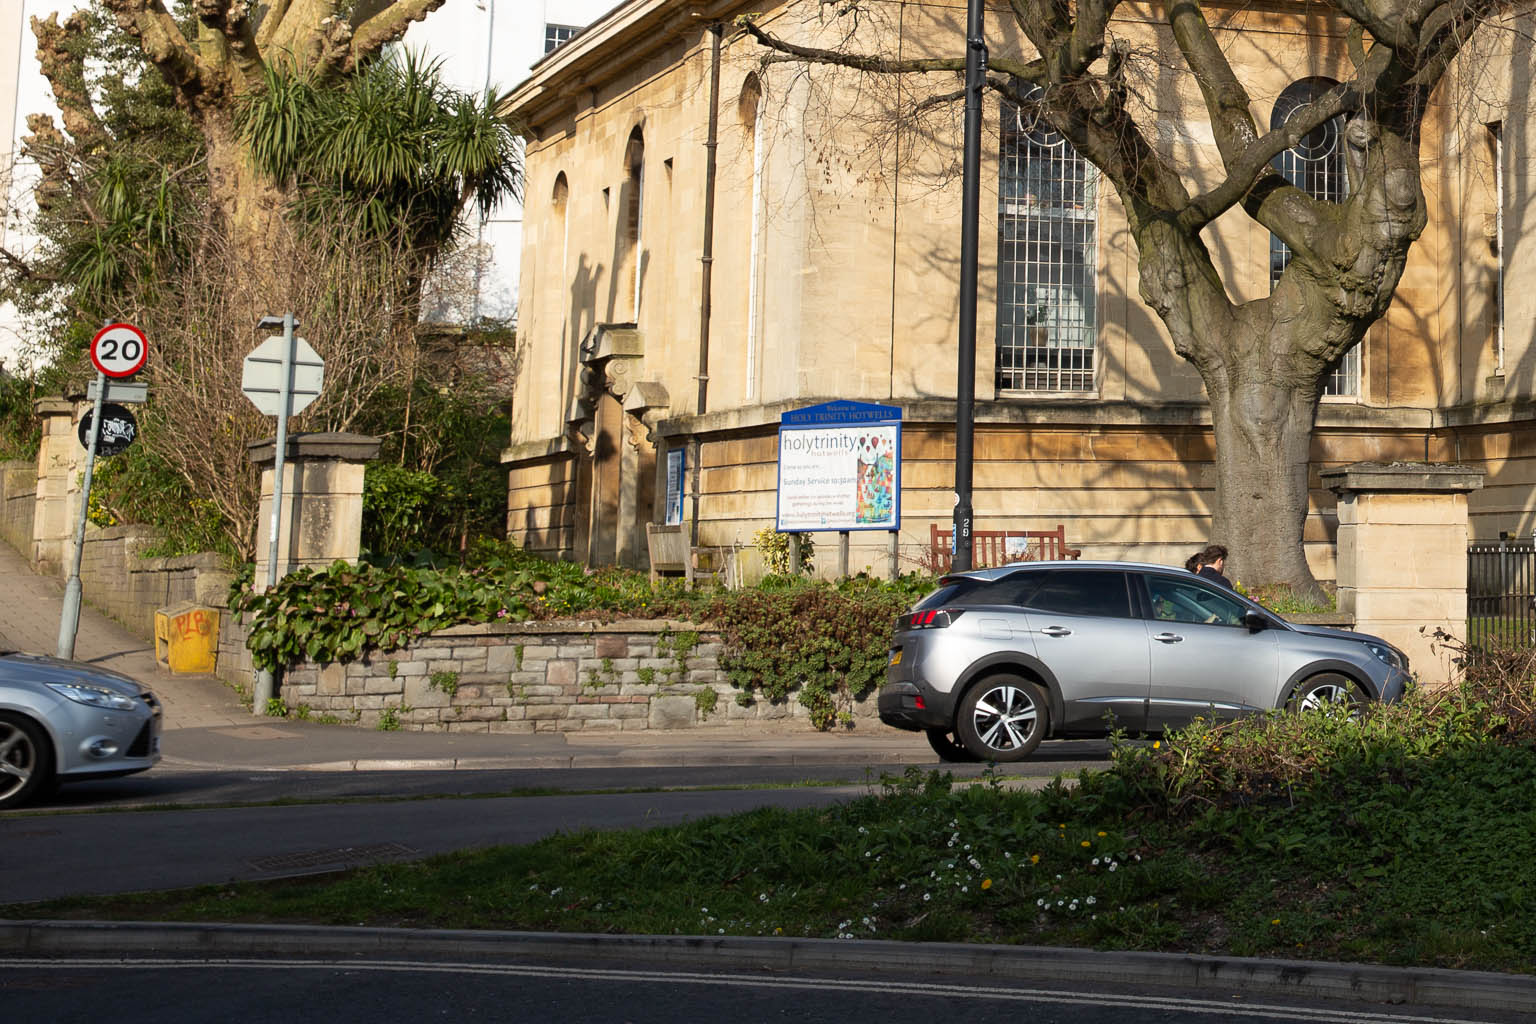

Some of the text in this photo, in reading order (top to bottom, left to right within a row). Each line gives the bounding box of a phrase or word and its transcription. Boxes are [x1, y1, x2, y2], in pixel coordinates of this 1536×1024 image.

[100, 339, 141, 361] 20
[791, 410, 893, 422] HOLY TRINITY HOTWELLS
[783, 433, 858, 454] holytrinity
[810, 449, 849, 457] hotwells
[783, 478, 806, 486] Sunday
[807, 477, 830, 485] Service
